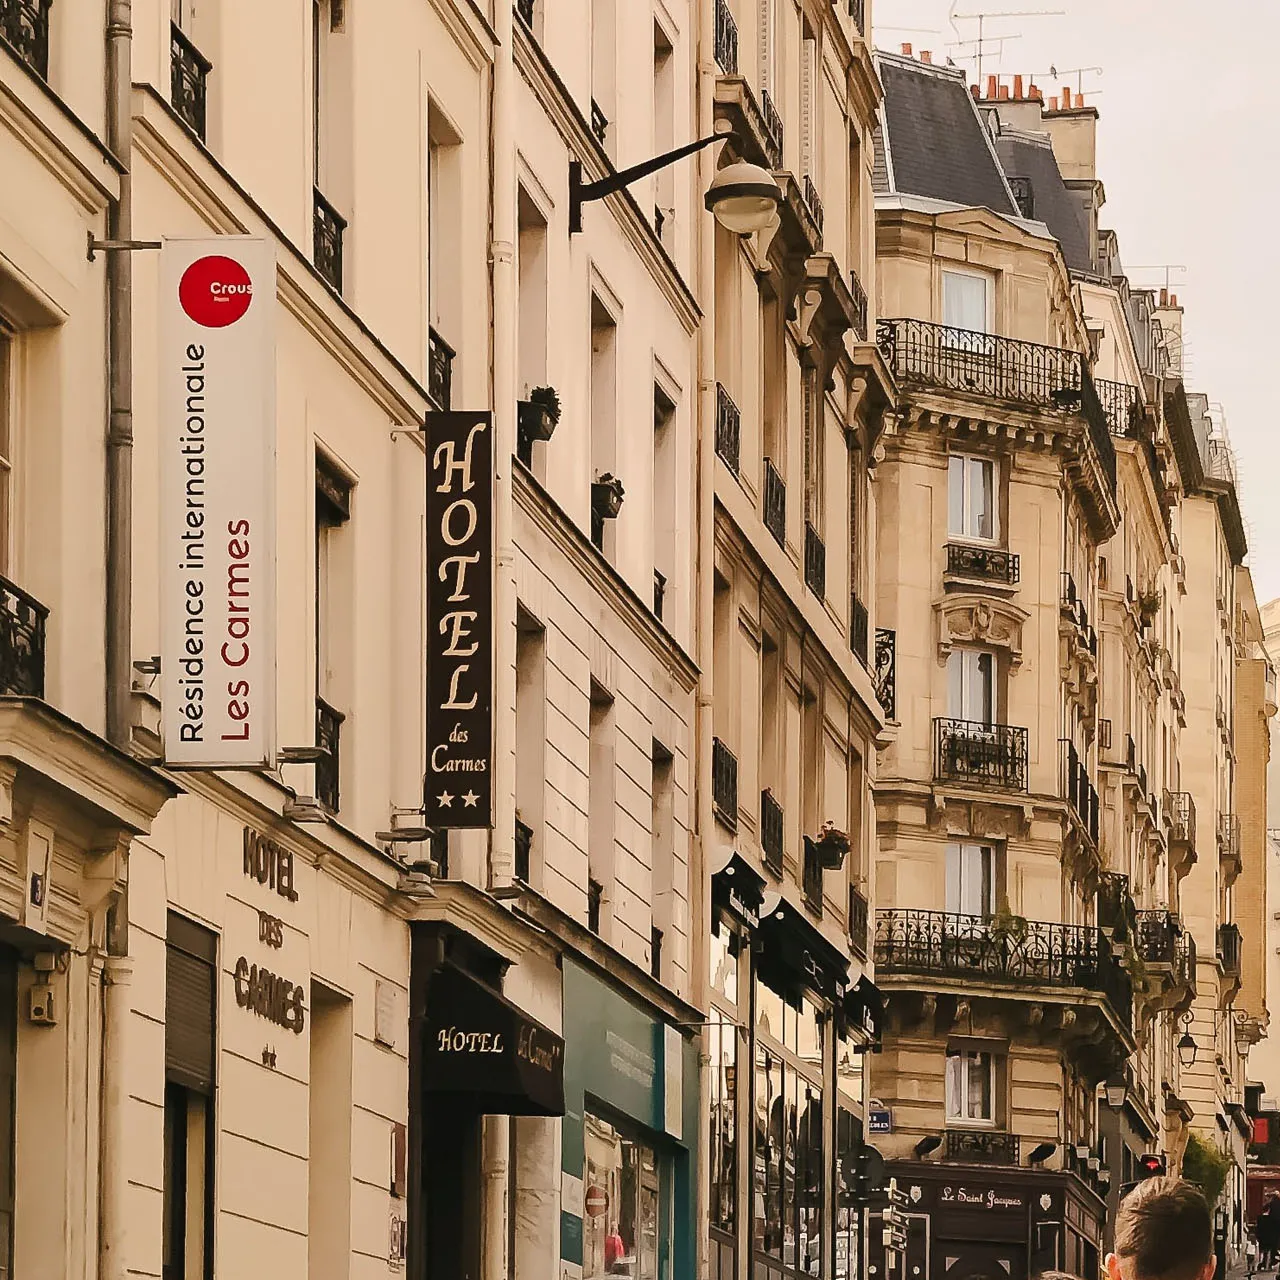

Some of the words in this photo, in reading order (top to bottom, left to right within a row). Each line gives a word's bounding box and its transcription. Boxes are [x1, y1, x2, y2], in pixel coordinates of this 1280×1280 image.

[210, 281, 254, 295] Crous
[179, 344, 205, 569] internationale
[220, 519, 250, 667] Carmes
[433, 422, 486, 710] HOTEL
[179, 580, 204, 742] Résidence
[220, 680, 250, 741] Les
[449, 722, 469, 743] des
[431, 744, 487, 772] Carmes
[242, 825, 299, 902] HOTEL
[438, 1026, 504, 1053] HOTEL
[941, 1186, 955, 1201] Le
[957, 1187, 983, 1203] Saint
[985, 1189, 1022, 1209] Jacques
